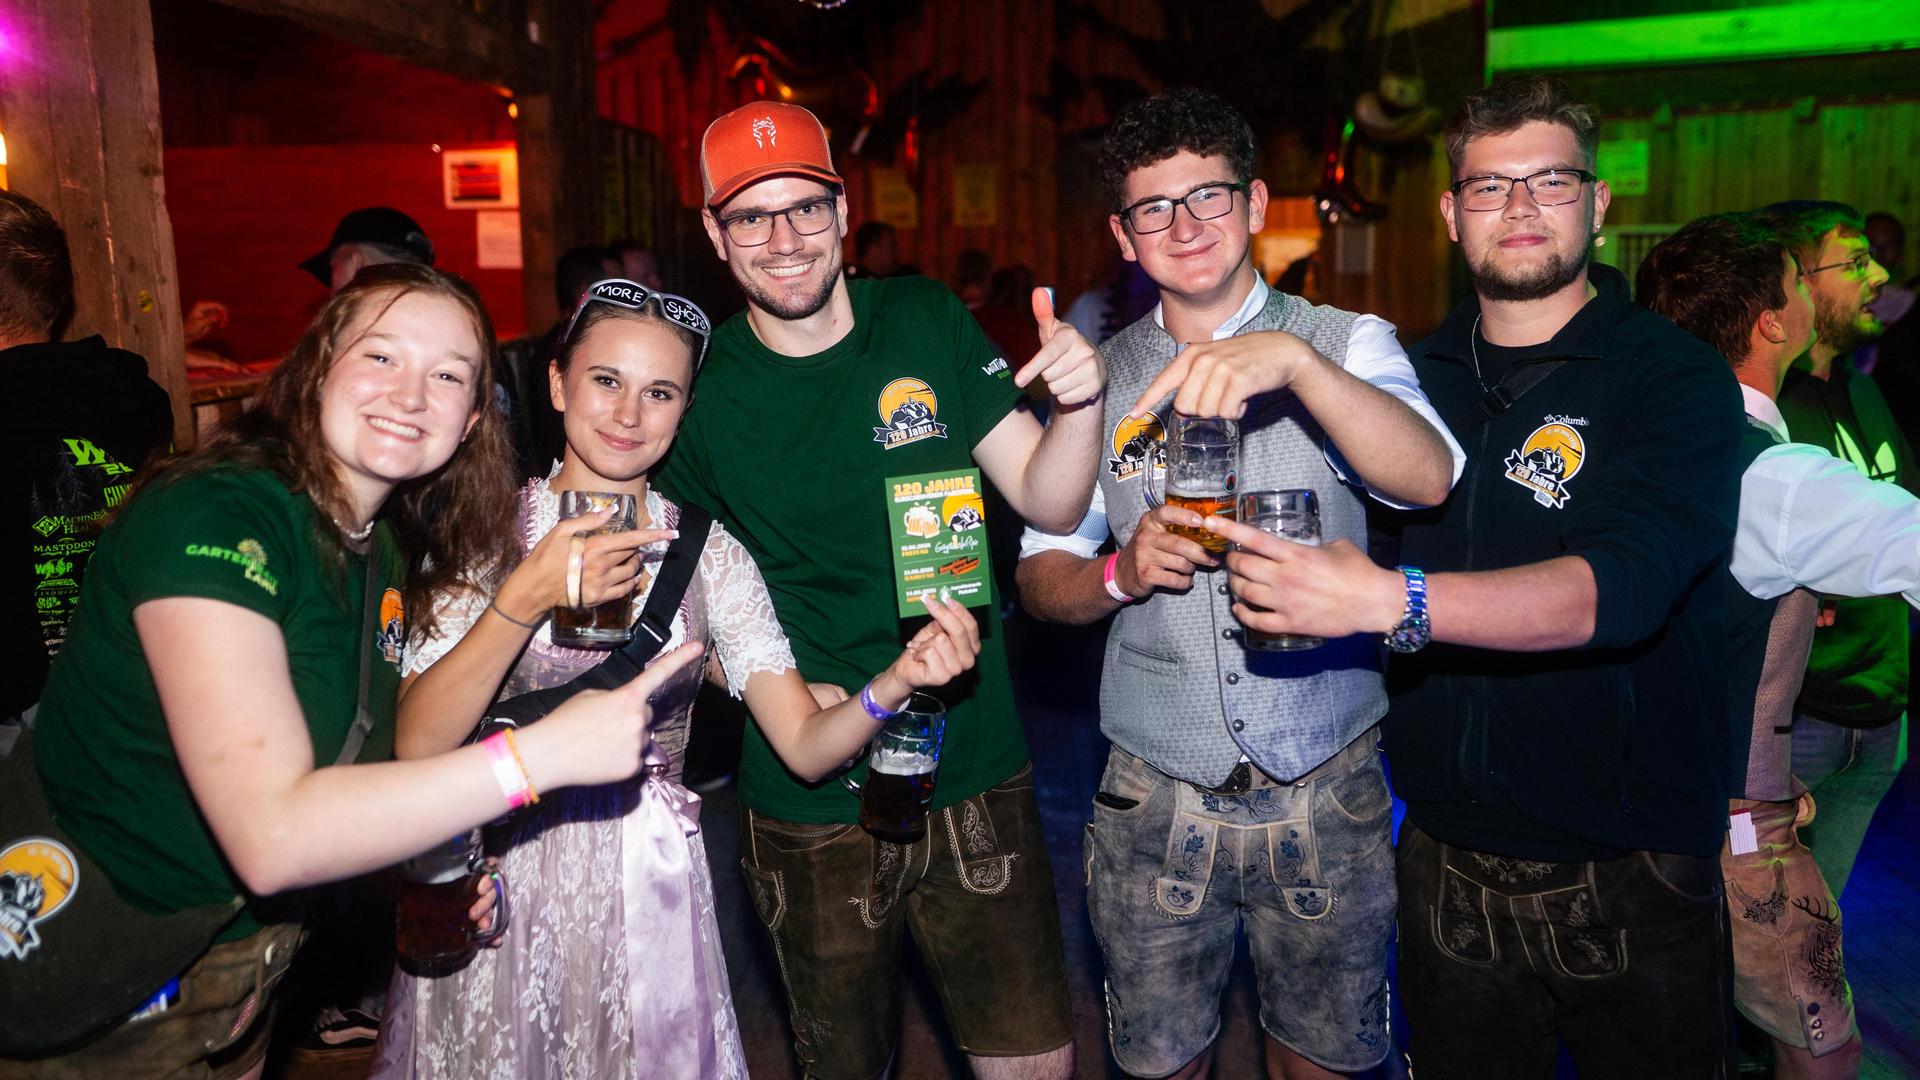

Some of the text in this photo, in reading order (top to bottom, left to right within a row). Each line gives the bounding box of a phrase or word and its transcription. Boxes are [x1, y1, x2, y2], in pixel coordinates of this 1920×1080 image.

[596, 285, 707, 330] MORE SHOTS
[889, 430, 908, 443] 120
[907, 423, 933, 438] Jahre
[894, 476, 975, 497] 120 JAHRE
[1528, 472, 1556, 491] Jahre
[33, 540, 95, 552] MASTODON
